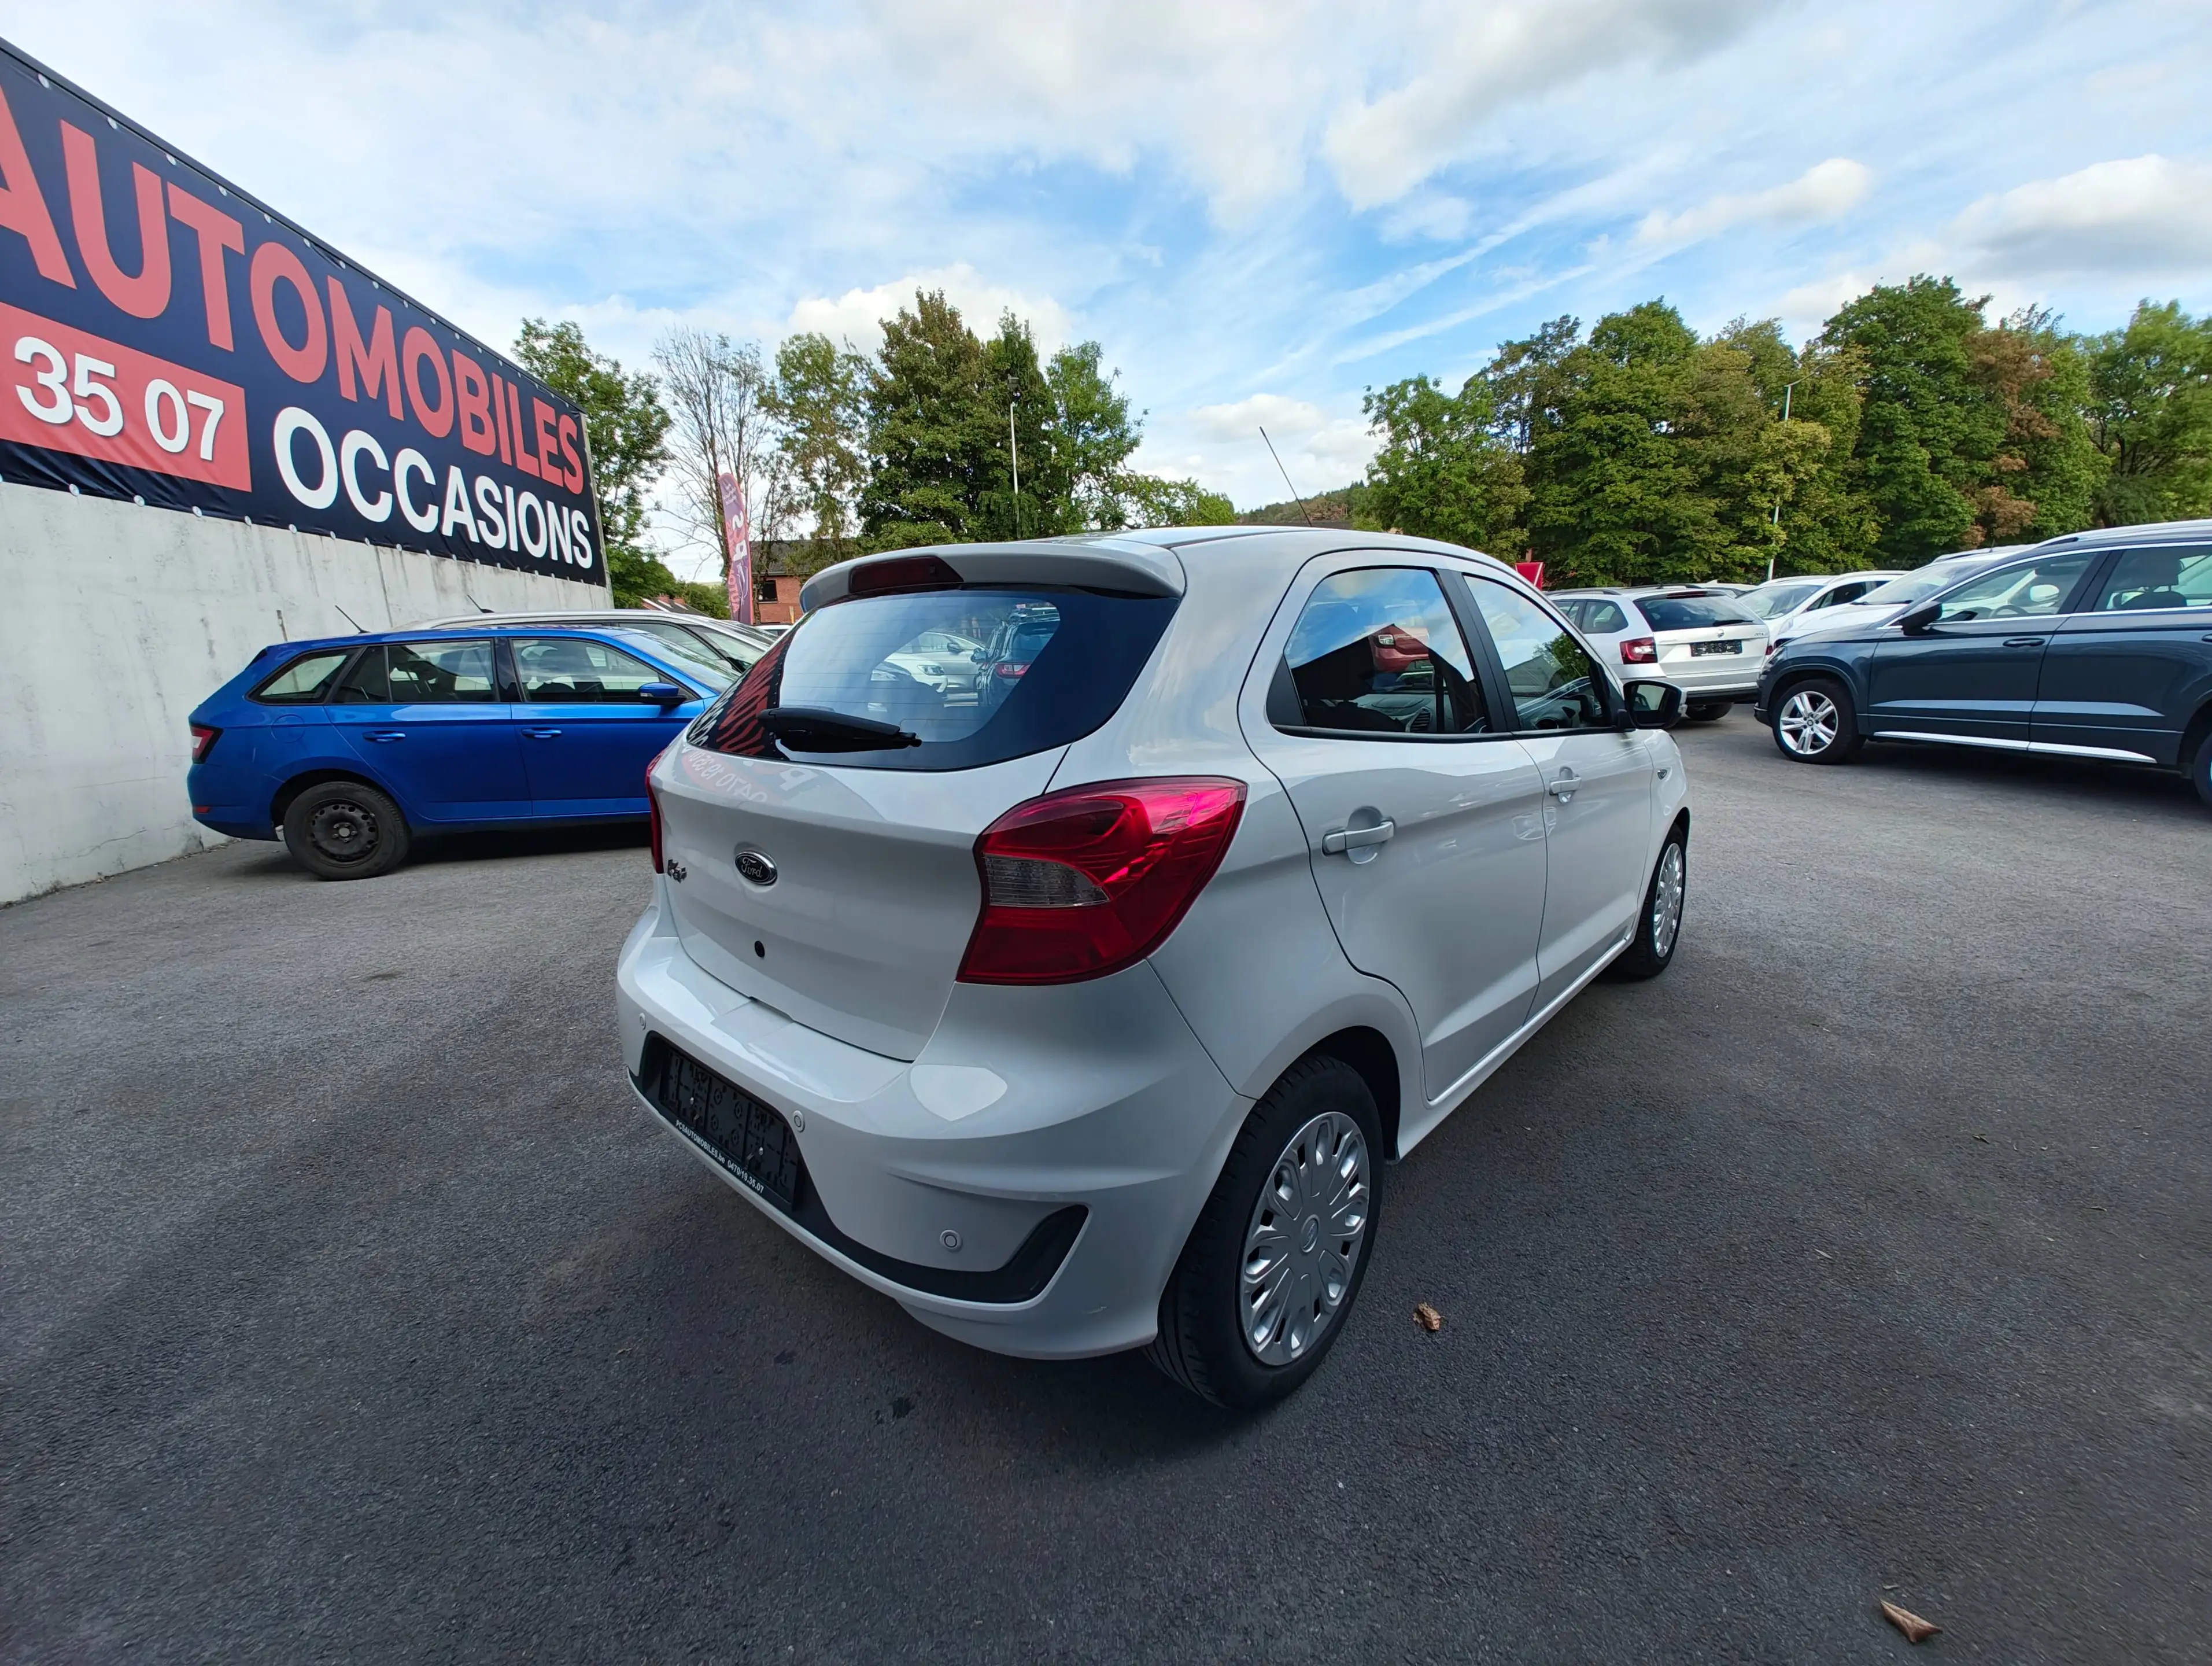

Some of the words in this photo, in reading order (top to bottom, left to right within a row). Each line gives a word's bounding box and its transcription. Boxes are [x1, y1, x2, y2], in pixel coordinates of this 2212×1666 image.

[14, 336, 123, 437] 35
[145, 378, 224, 461] 07
[274, 406, 593, 569] OCCASIONS
[741, 856, 763, 878] Ford
